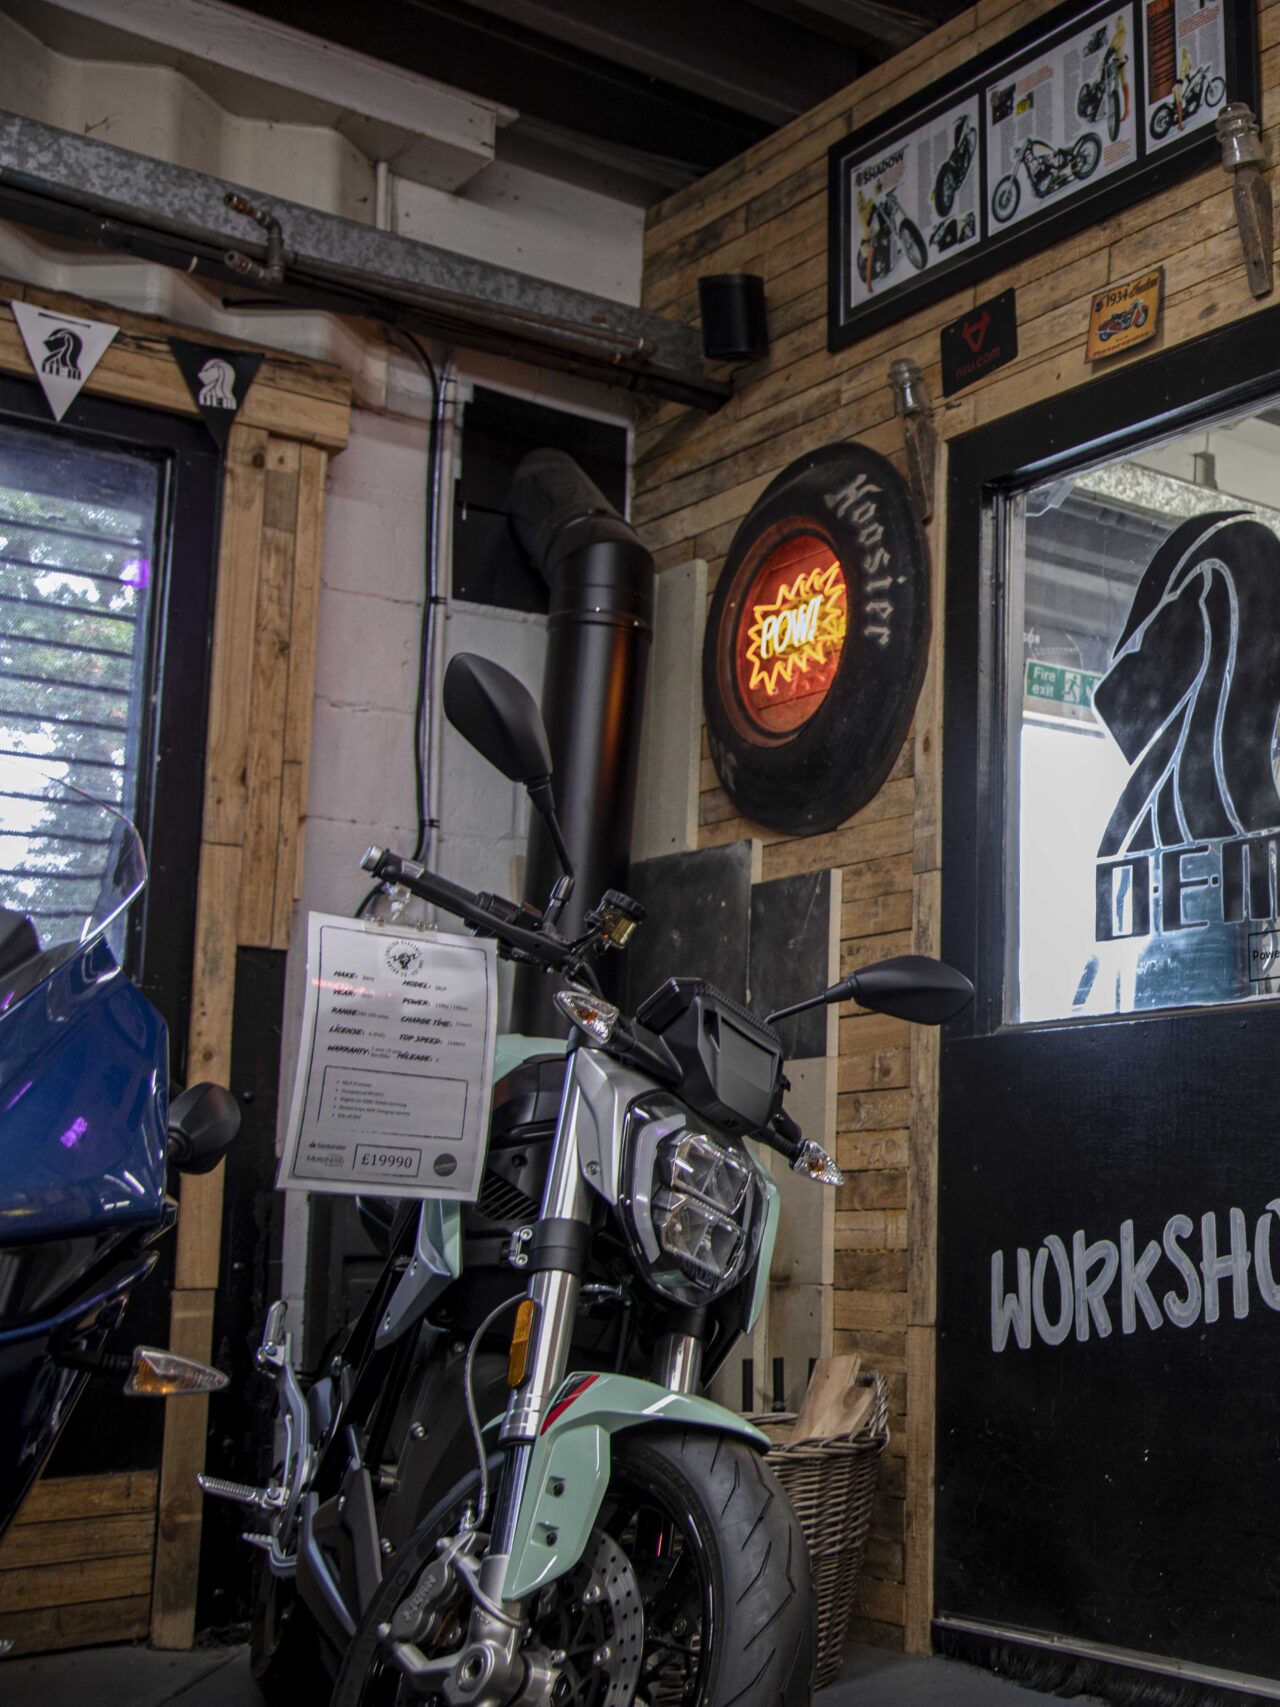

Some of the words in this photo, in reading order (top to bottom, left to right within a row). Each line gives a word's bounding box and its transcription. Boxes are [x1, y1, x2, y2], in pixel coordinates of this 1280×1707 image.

[823, 473, 906, 648] Hoosier
[1033, 667, 1056, 682] Fire
[1032, 683, 1054, 697] exit
[334, 970, 358, 979] MAKE:
[402, 980, 431, 989] MODEL:
[333, 989, 356, 997] YEAR:
[402, 997, 431, 1007] POWER:
[331, 1006, 360, 1016] RANGE:
[400, 1015, 432, 1025] CHARGE
[433, 1017, 453, 1027] TIME:
[329, 1024, 365, 1035] LICENSE:
[415, 1035, 442, 1044] SPEED:
[327, 1044, 370, 1055] WARRANTY:
[397, 1051, 432, 1062] MILEAGE:
[361, 1153, 413, 1169] £19990
